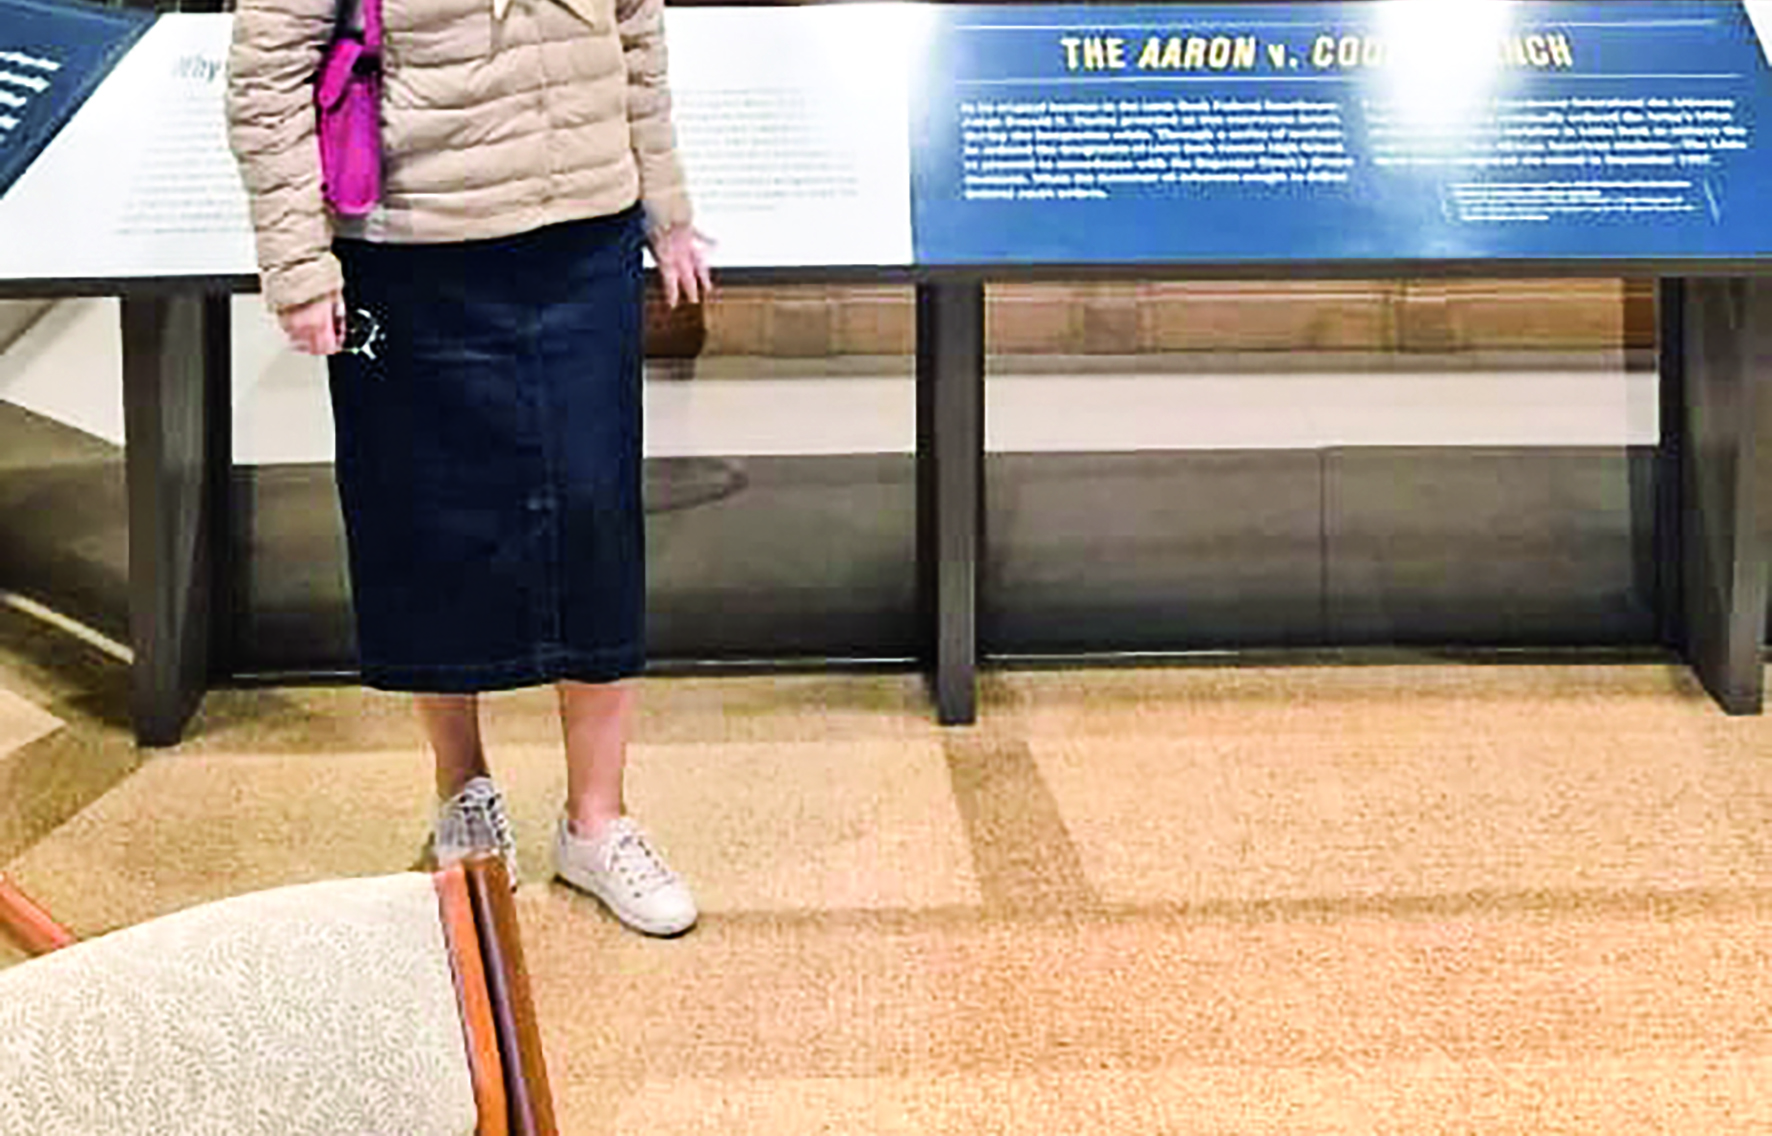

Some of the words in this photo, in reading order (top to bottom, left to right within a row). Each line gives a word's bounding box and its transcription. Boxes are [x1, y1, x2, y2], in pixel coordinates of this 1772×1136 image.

[1061, 37, 1127, 70] THE
[1138, 36, 1256, 70] AARON
[1268, 44, 1299, 68] v.
